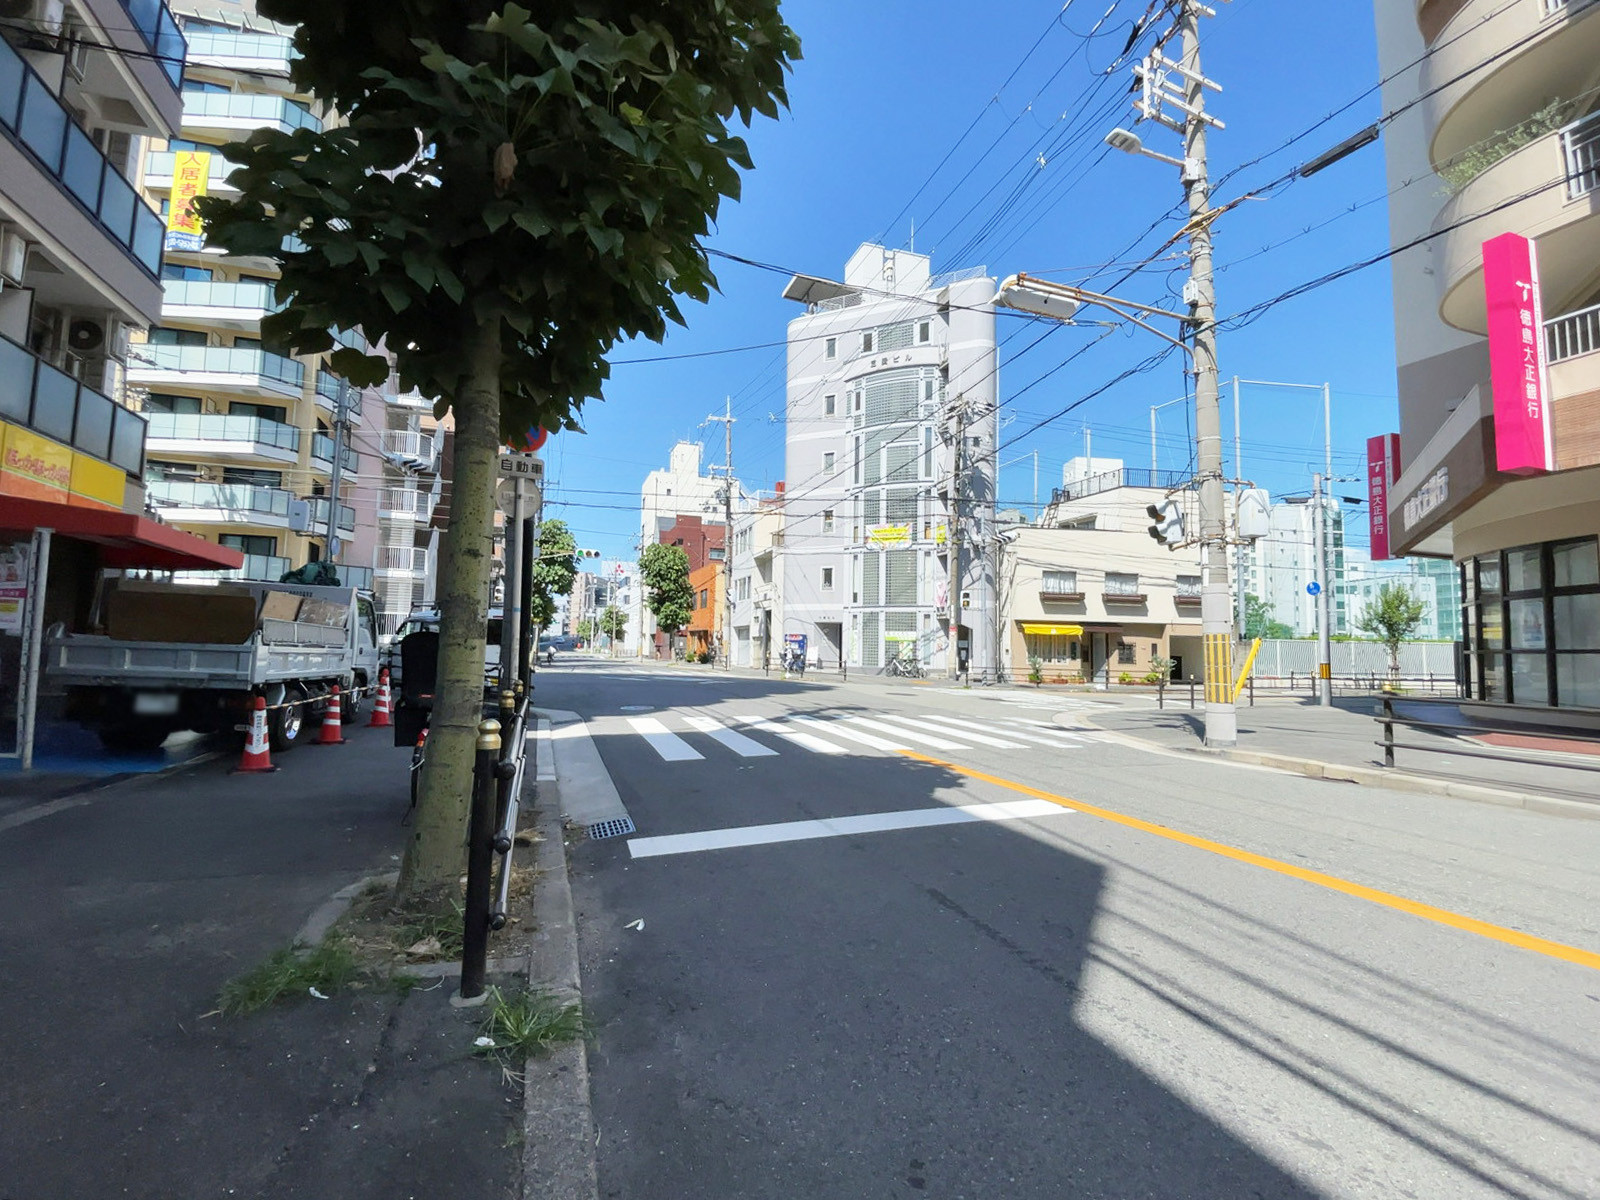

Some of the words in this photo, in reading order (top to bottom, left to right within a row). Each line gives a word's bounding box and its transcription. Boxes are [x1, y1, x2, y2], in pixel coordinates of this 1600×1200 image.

[1519, 307, 1540, 420] 徳島大正銀行
[500, 459, 543, 475] 自動車
